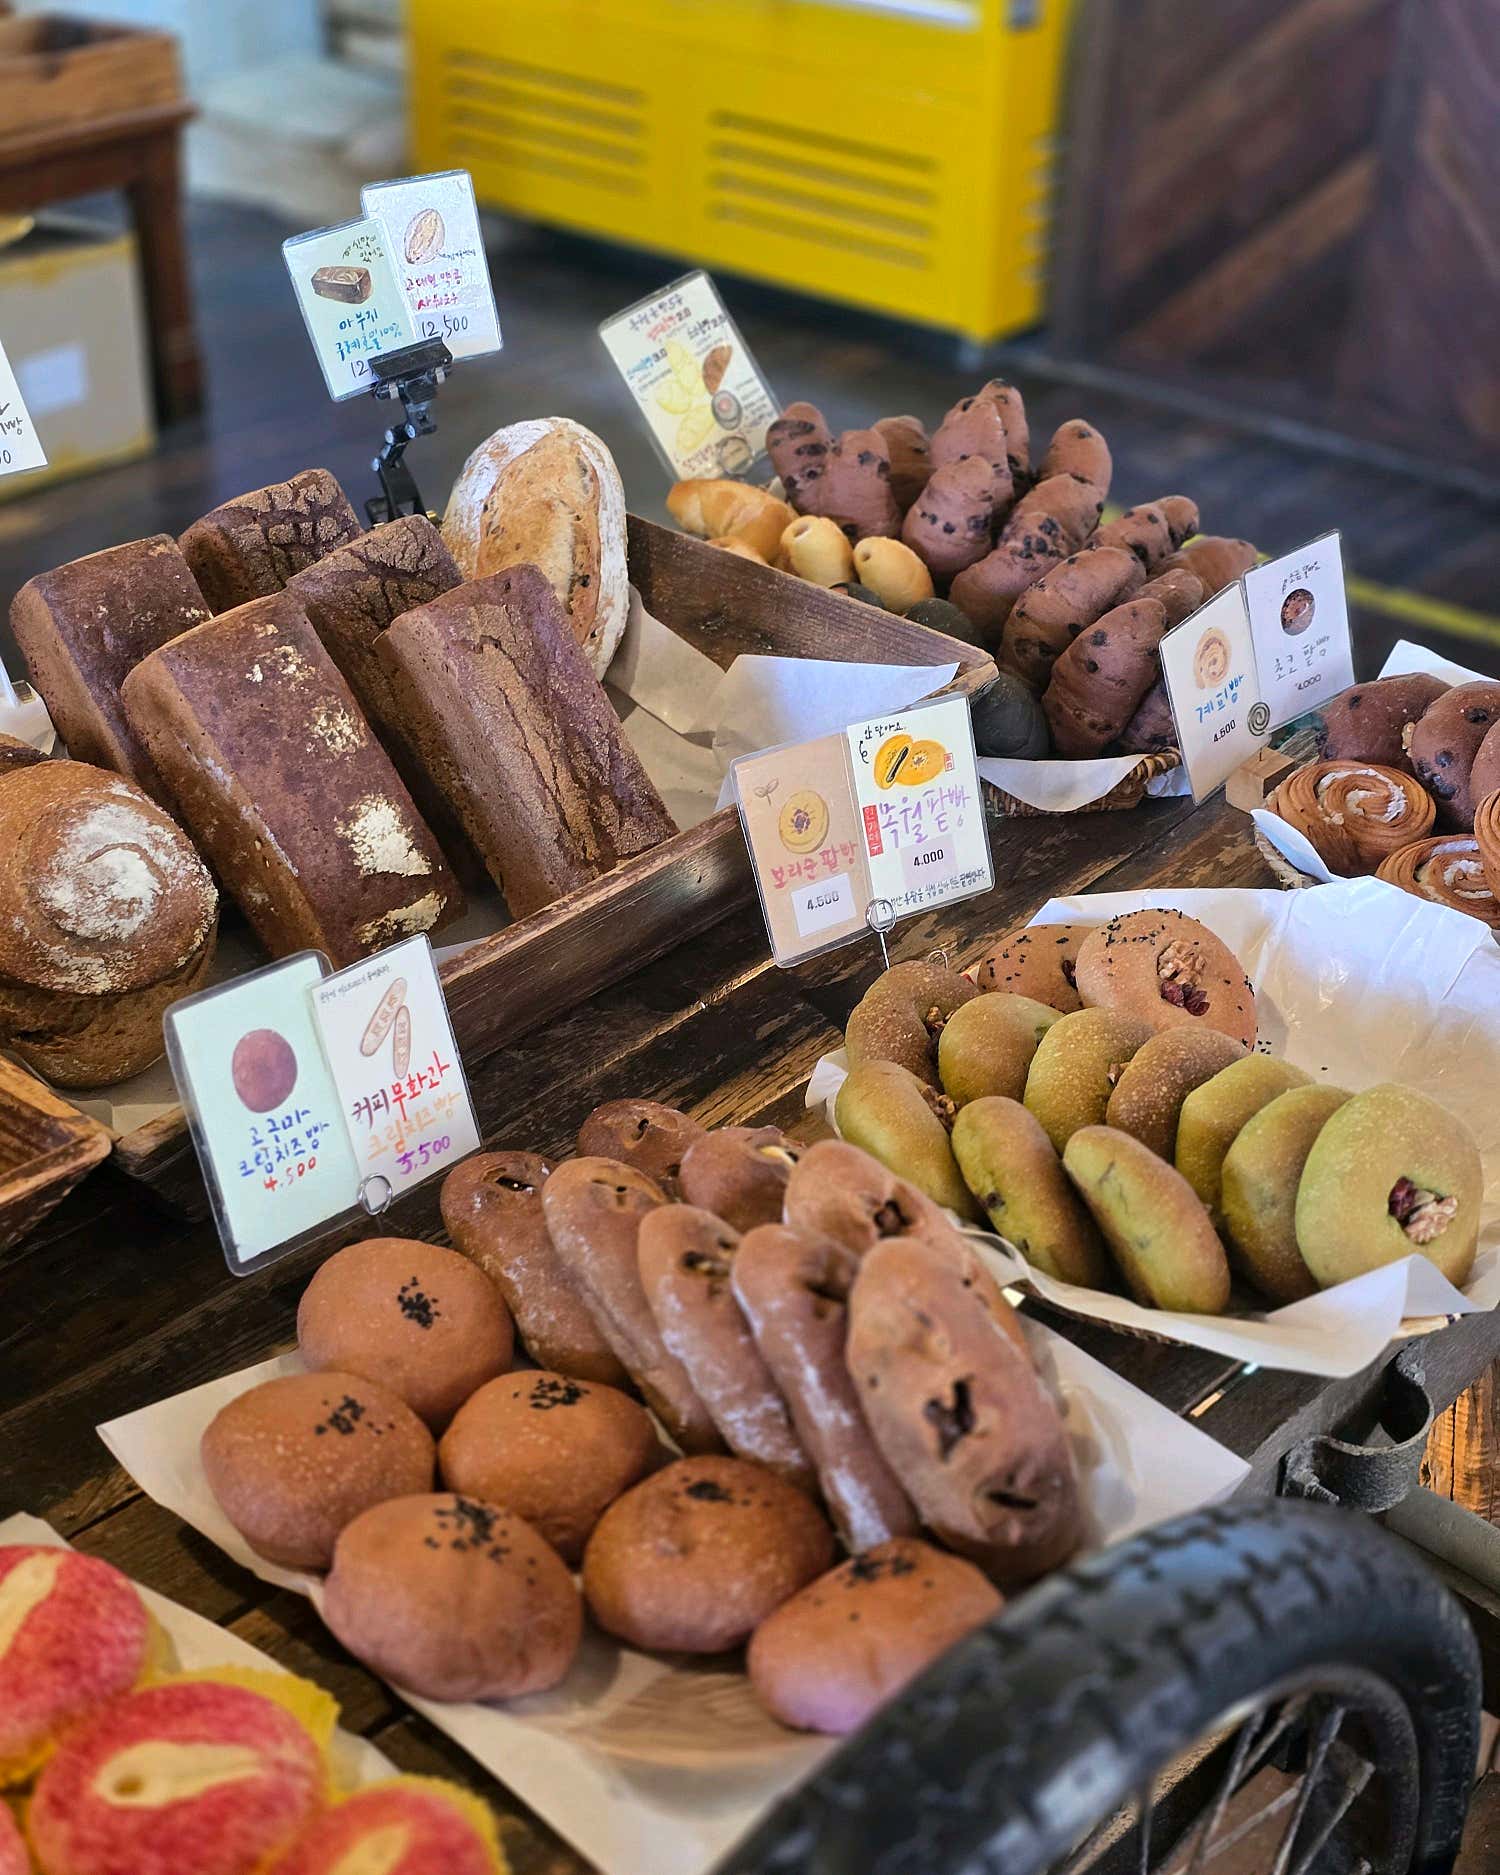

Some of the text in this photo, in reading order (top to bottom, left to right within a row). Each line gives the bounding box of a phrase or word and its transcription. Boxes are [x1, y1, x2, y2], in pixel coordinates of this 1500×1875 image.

[1195, 674, 1245, 723] 계피빵
[913, 849, 944, 867] 4.000
[806, 891, 840, 910] 4.500
[249, 1109, 311, 1146] 고구마
[367, 1091, 462, 1161] 크림치즈빵
[240, 1122, 330, 1177] 크림치즈빵
